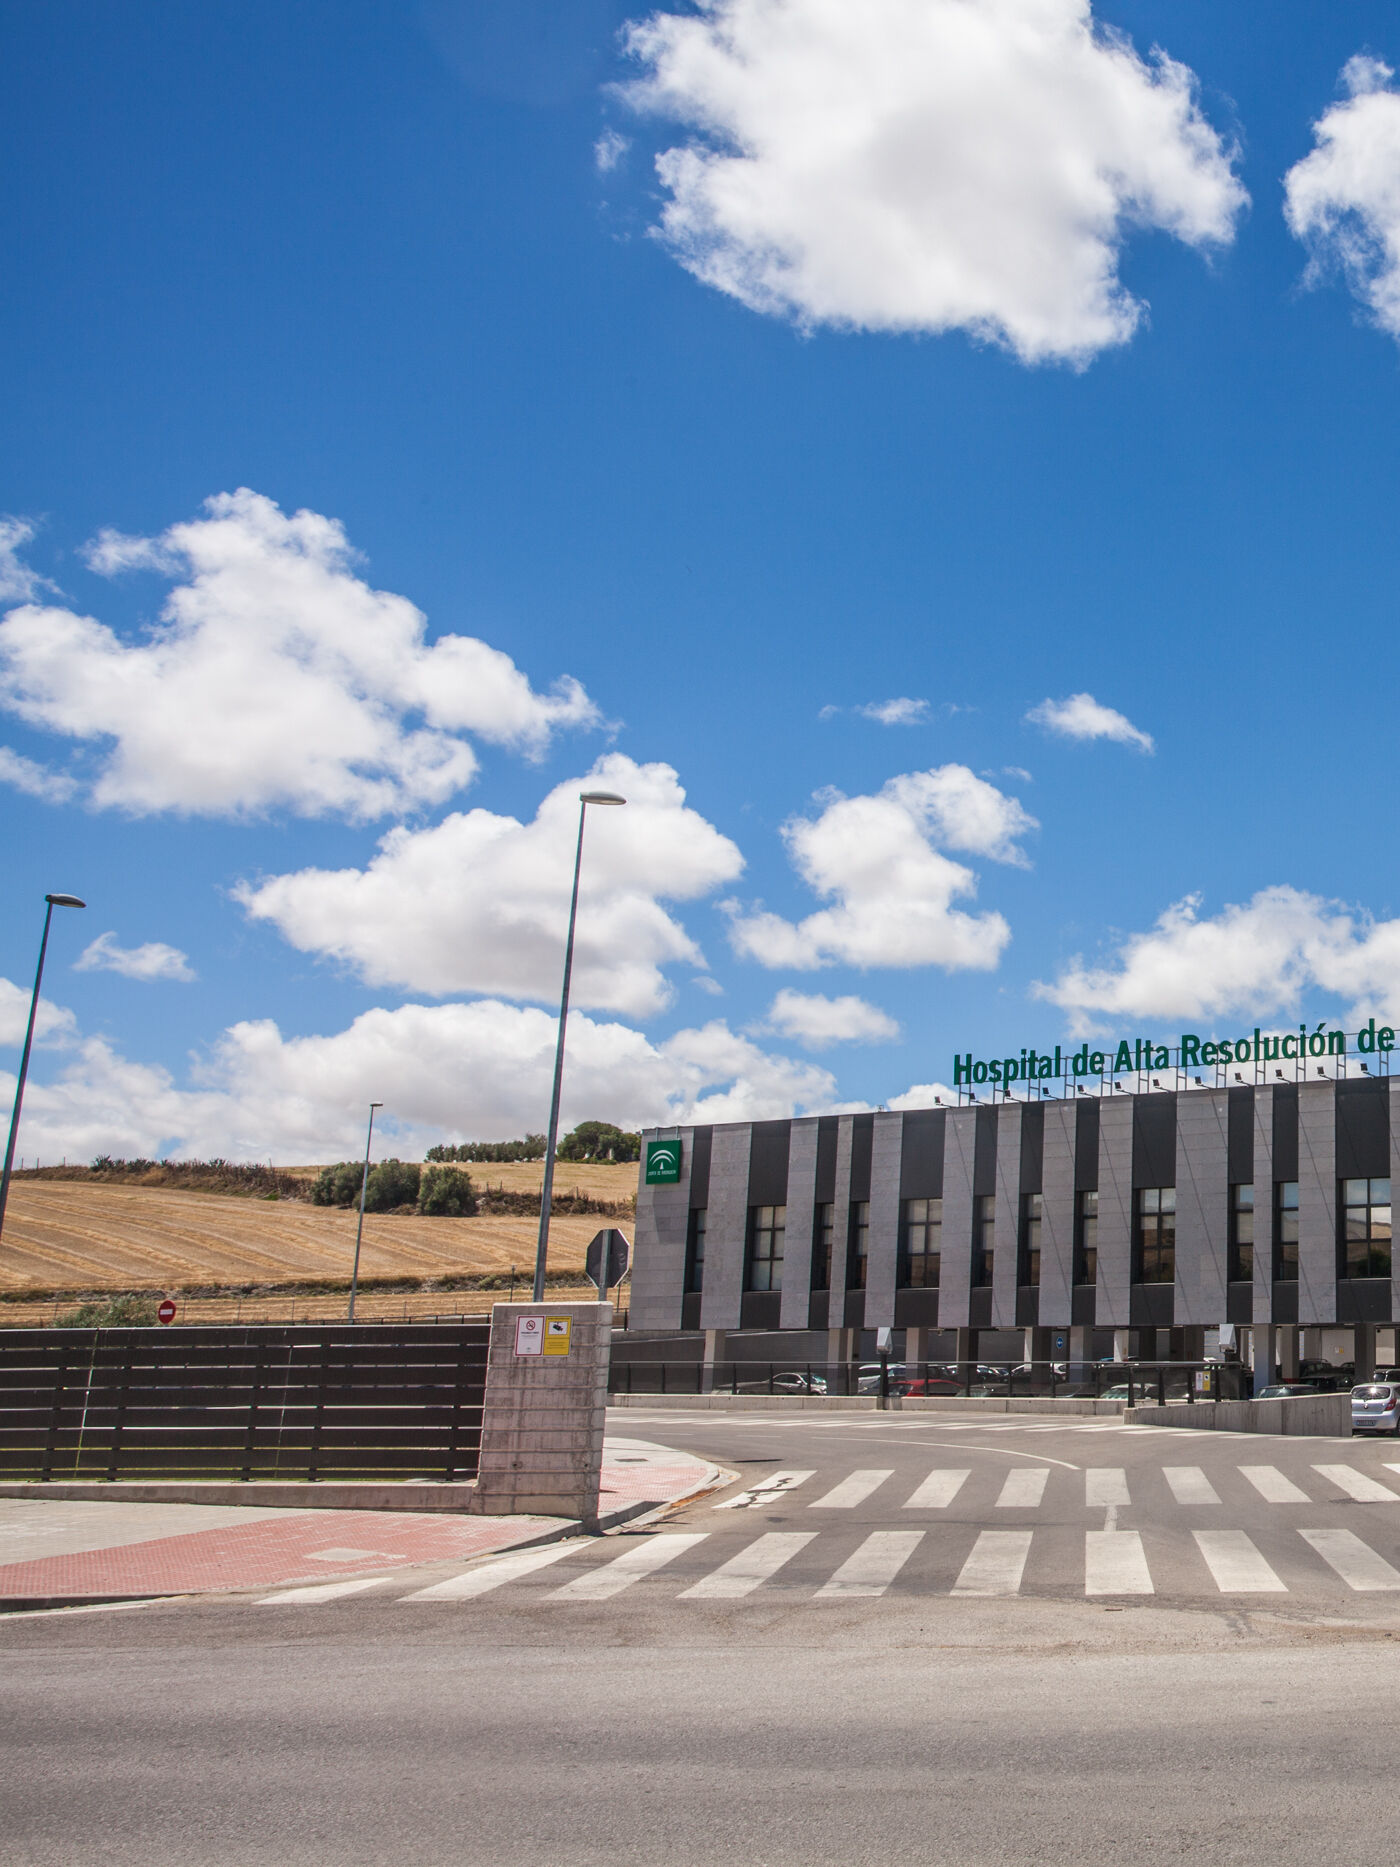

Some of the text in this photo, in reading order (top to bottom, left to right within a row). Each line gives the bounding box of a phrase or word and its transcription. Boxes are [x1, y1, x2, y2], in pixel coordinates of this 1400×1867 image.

[954, 1046, 1061, 1091] Hospital
[1072, 1044, 1104, 1077] de
[1114, 1038, 1169, 1073] Alta
[1181, 1023, 1345, 1067] Resolución
[1358, 1018, 1395, 1053] de
